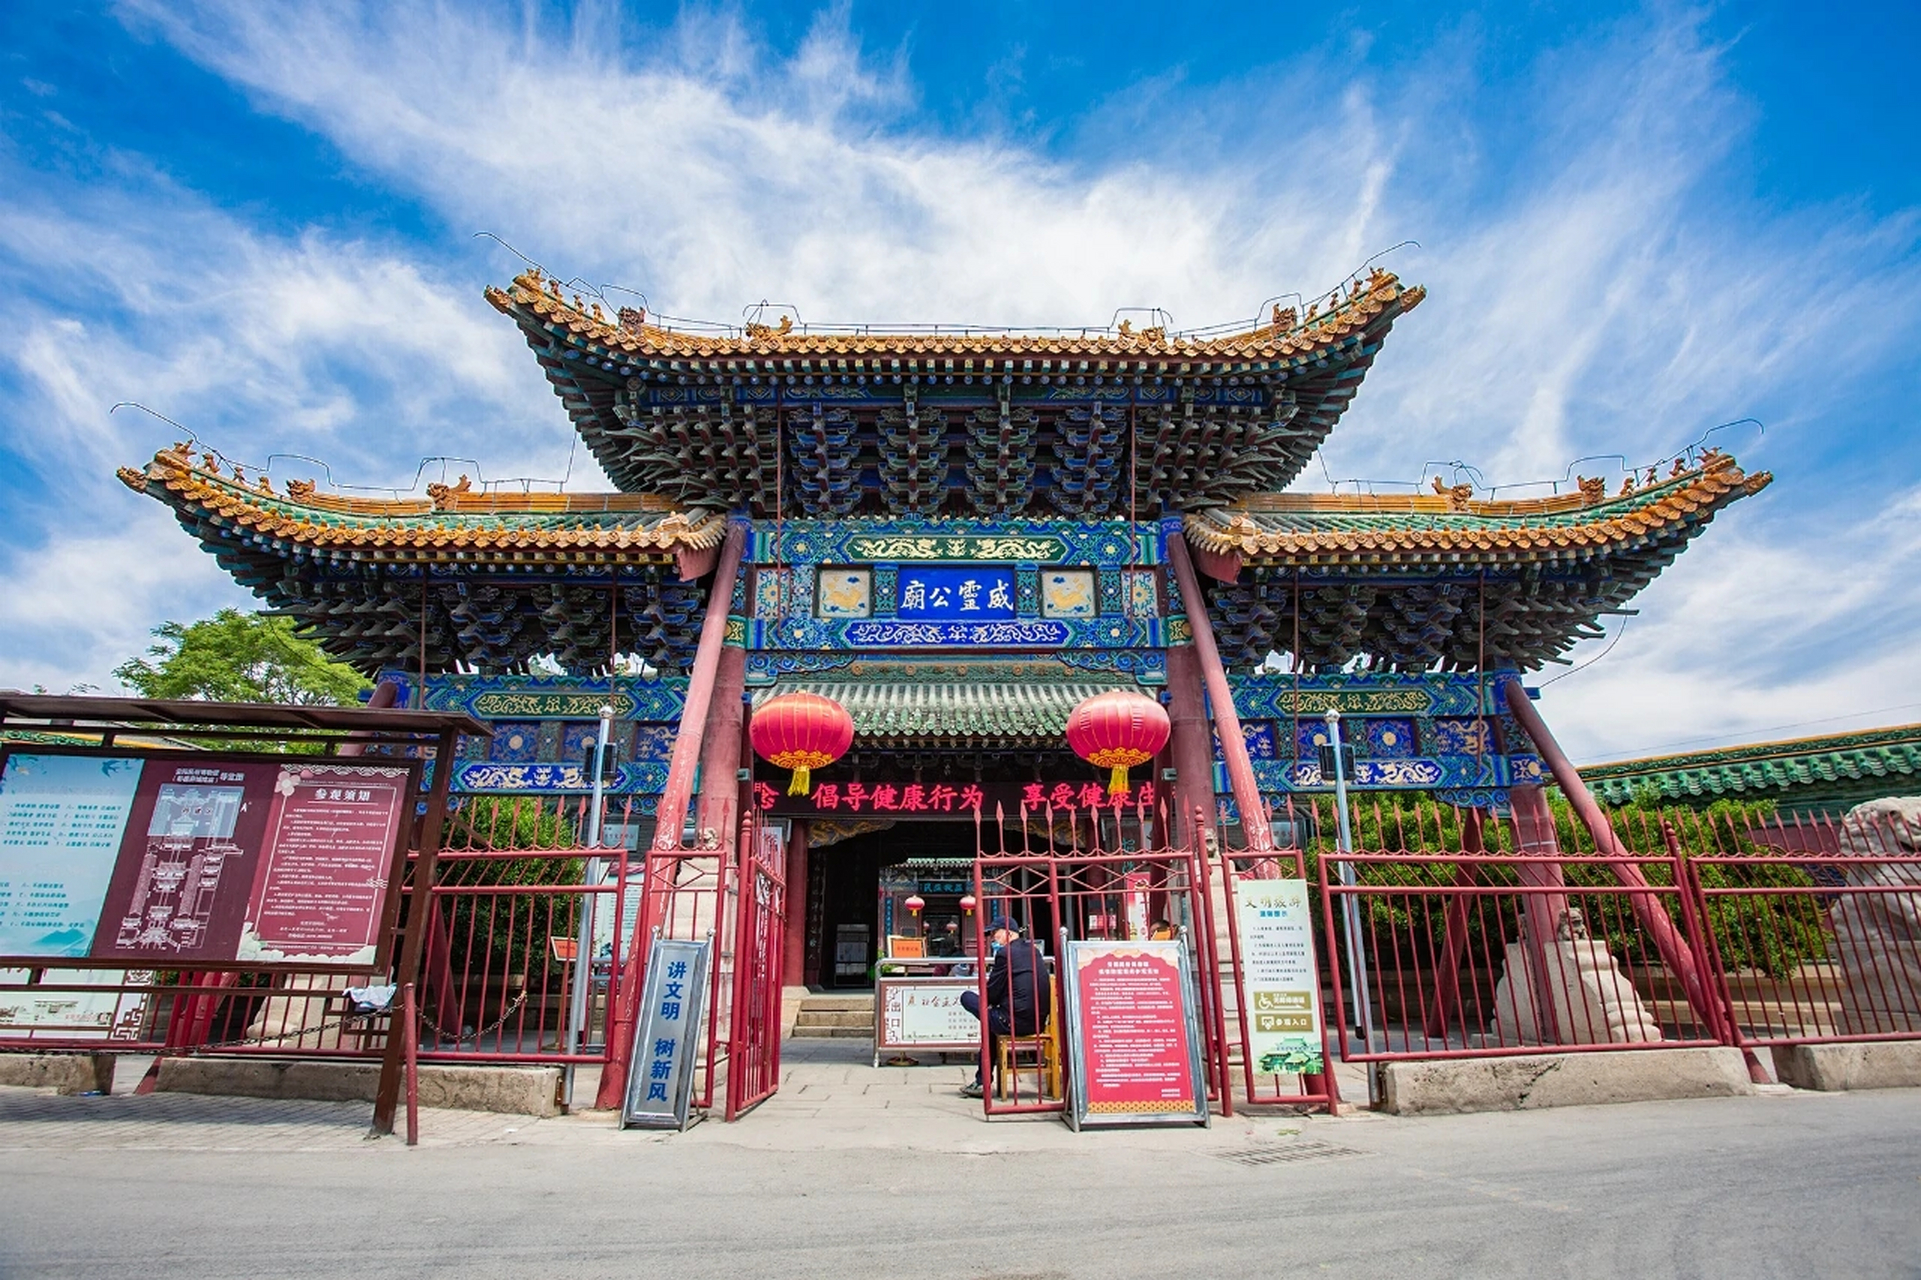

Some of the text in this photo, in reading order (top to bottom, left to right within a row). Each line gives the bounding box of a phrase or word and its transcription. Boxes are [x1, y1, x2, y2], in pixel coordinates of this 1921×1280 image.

[314, 787, 371, 802] 参观须知
[810, 782, 984, 812] 倡导健康行为
[1022, 782, 1176, 811] 享受健康生
[646, 960, 687, 1102] 讲文明 树新风
